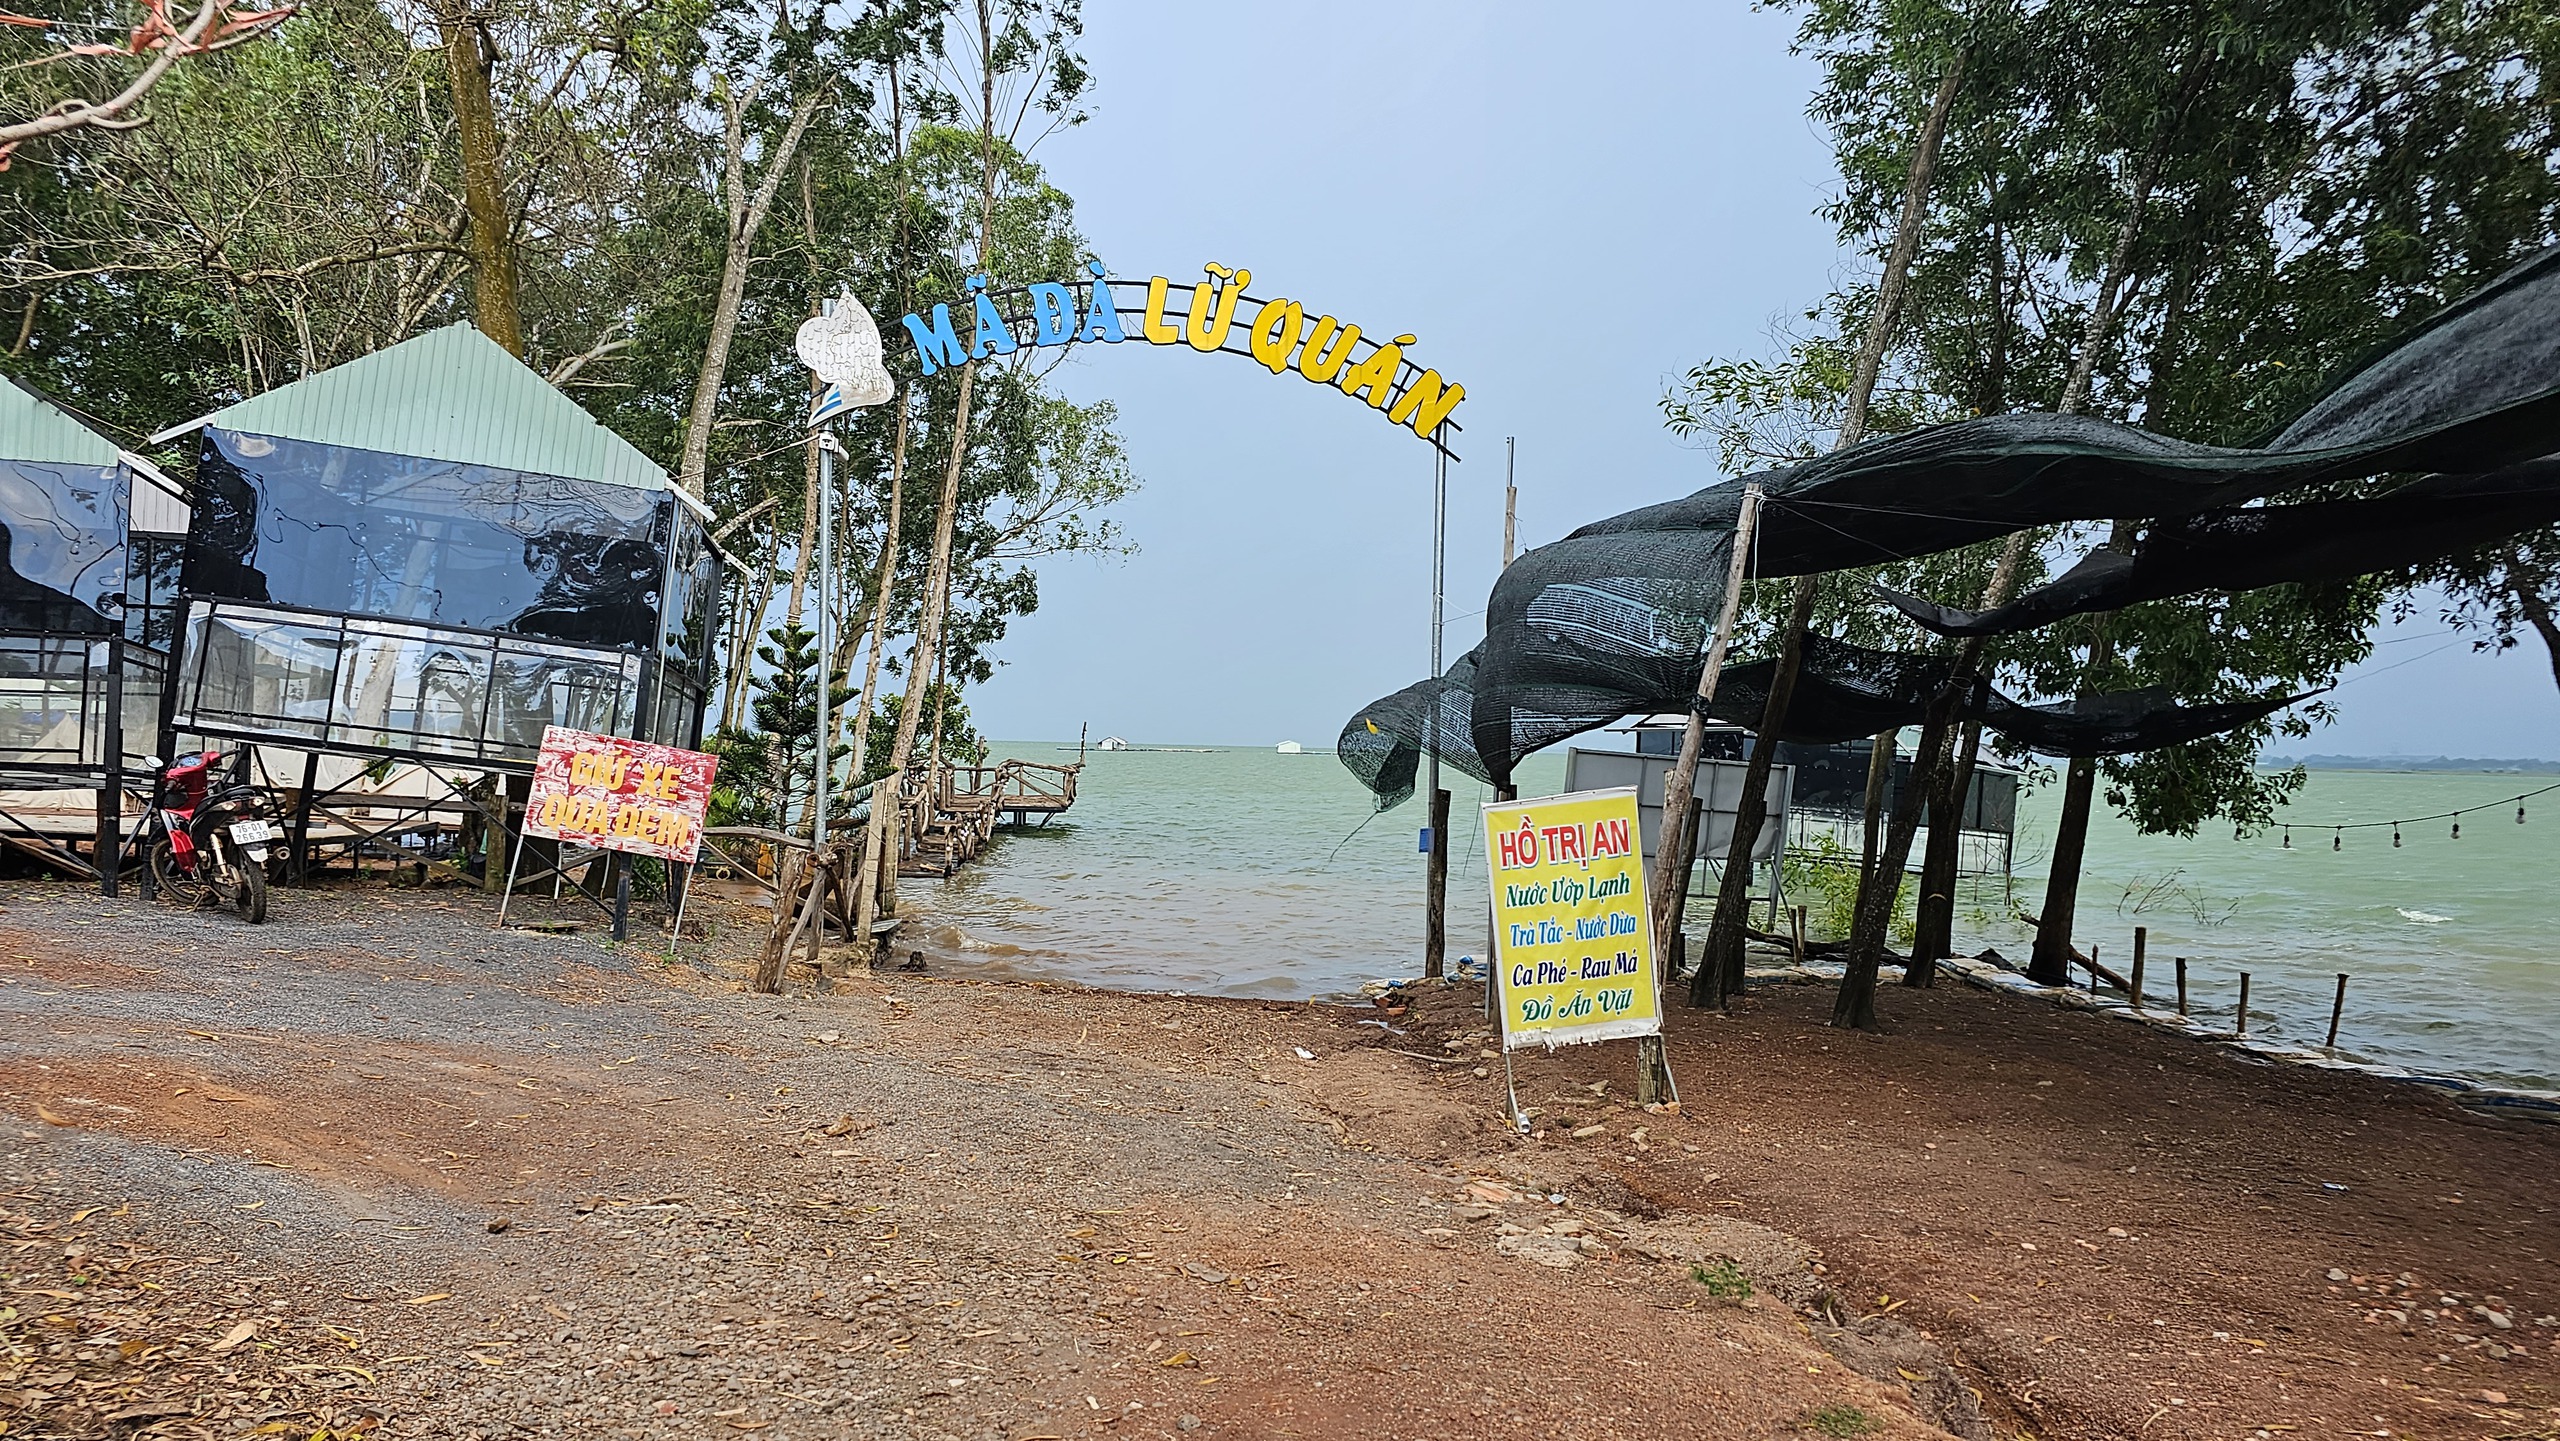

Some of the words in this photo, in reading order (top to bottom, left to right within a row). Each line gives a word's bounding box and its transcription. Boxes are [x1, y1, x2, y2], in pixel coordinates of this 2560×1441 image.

[902, 273, 1018, 376] MÃ
[1028, 261, 1126, 347] ĐÀ
[1143, 262, 1251, 353] LỮ
[1250, 298, 1466, 439] QUÁN
[569, 749, 632, 791] GIỮ
[636, 762, 682, 801] XE
[543, 793, 609, 835] QUA
[1499, 815, 1538, 868] HỒ
[1541, 824, 1586, 868] TRỊ
[1592, 819, 1630, 857] AN
[1506, 882, 1547, 908] Nước
[1589, 872, 1630, 904] Lạnh
[1510, 921, 1535, 947] Trà
[1539, 916, 1563, 945] Tắc
[1576, 915, 1607, 941] Nước
[1609, 910, 1636, 936] Dừa
[1512, 964, 1533, 987] Ca
[1581, 957, 1611, 980] Rau
[1614, 949, 1638, 975] Má
[1522, 995, 1554, 1022] Đồ
[1558, 989, 1592, 1018] Ăn
